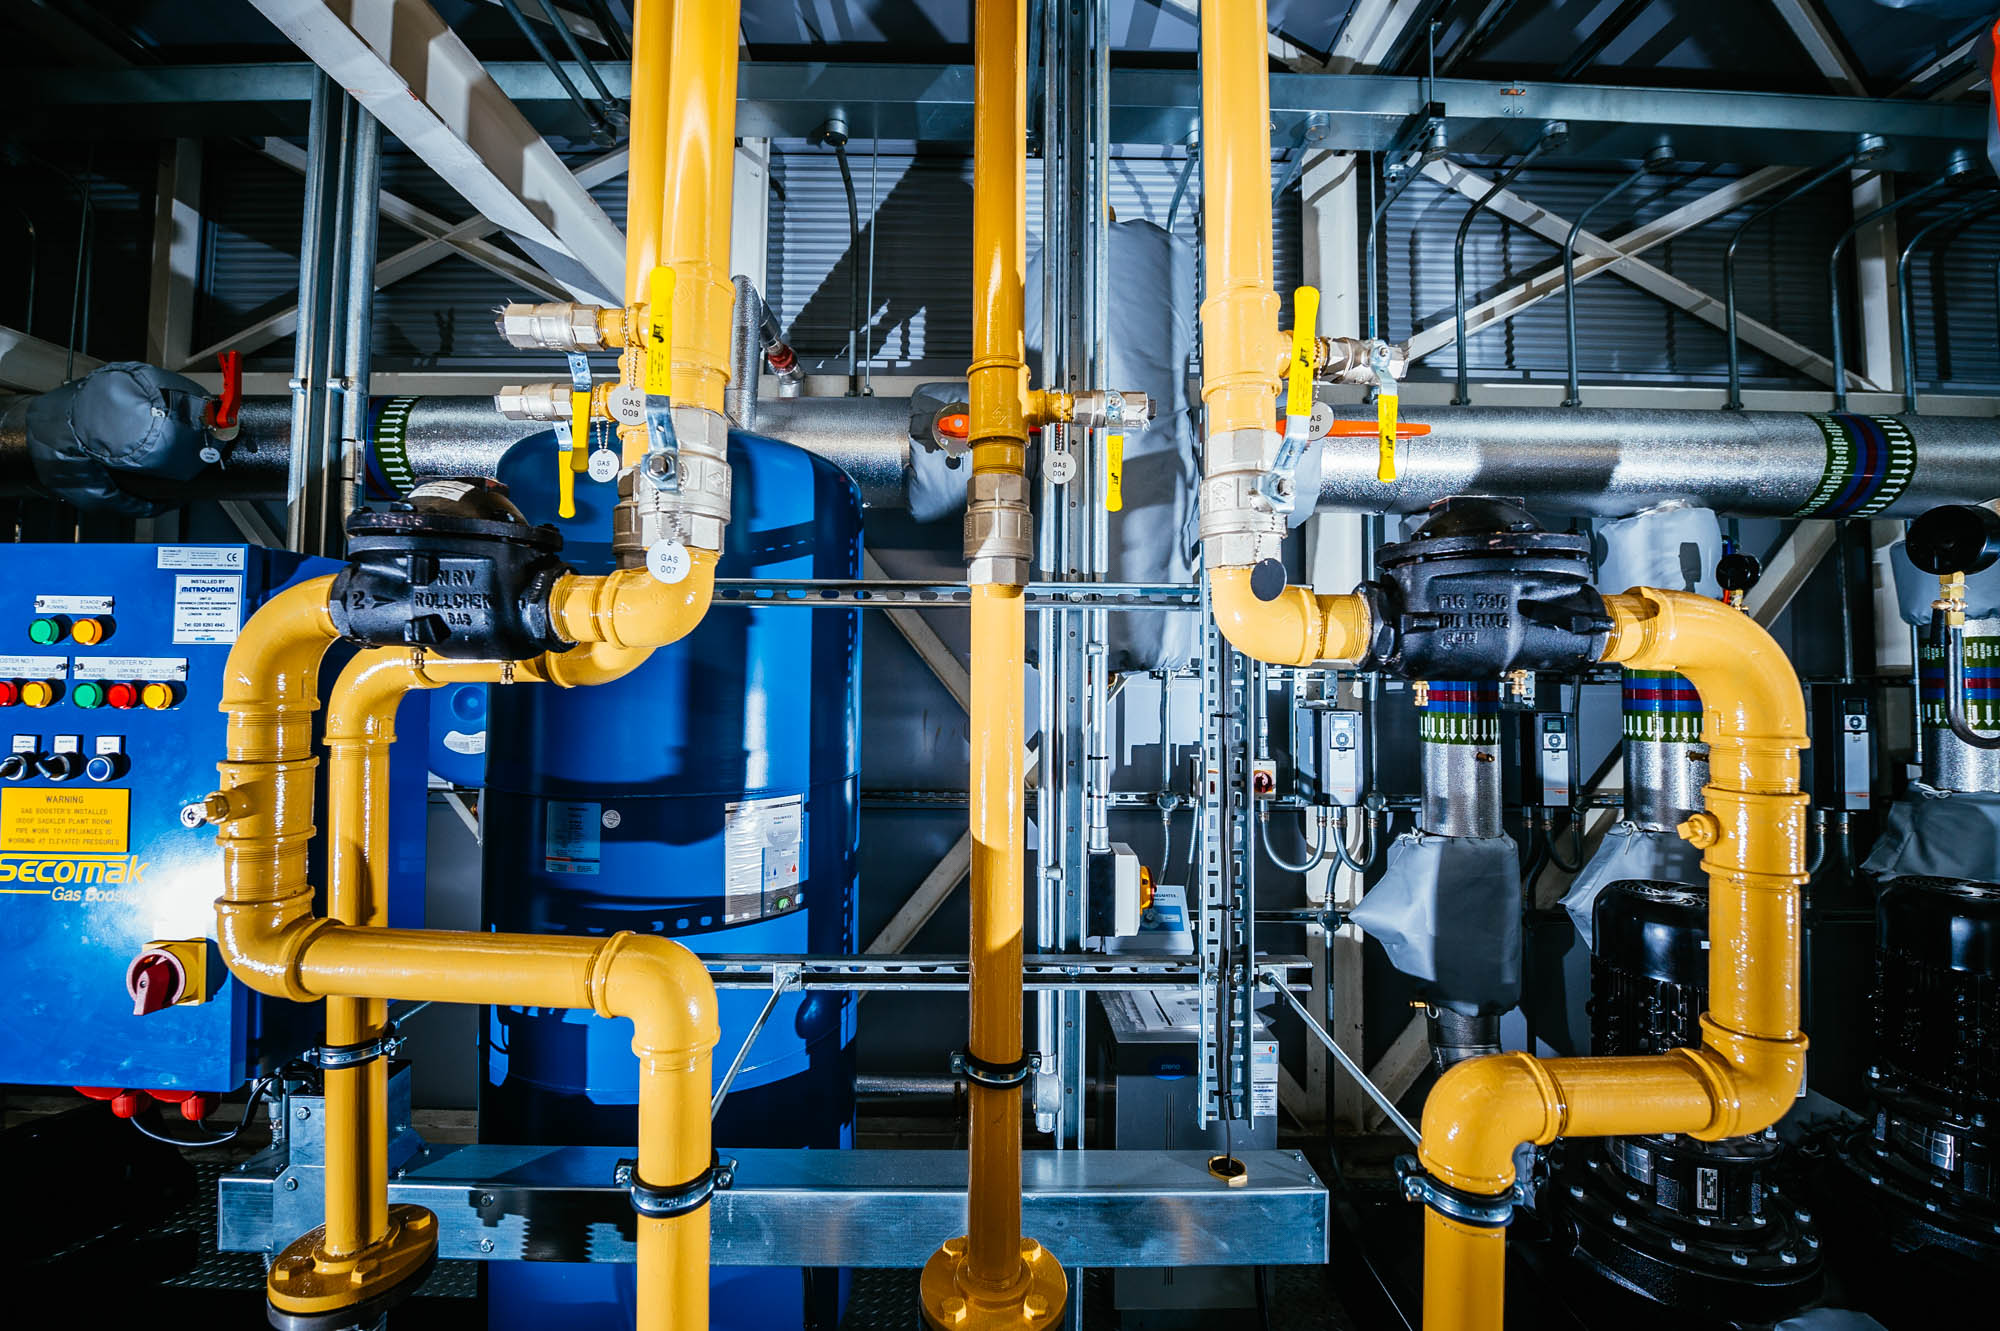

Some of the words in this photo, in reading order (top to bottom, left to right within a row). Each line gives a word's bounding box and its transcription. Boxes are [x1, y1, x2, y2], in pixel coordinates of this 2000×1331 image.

[653, 324, 664, 343] JET
[1300, 347, 1309, 367] JET
[622, 398, 640, 407] GAS
[623, 409, 638, 417] 009
[661, 554, 678, 563] GAS
[661, 565, 676, 574] 007
[438, 570, 476, 586] NRV
[46, 795, 84, 804] WARNING
[52, 886, 82, 901] Gas
